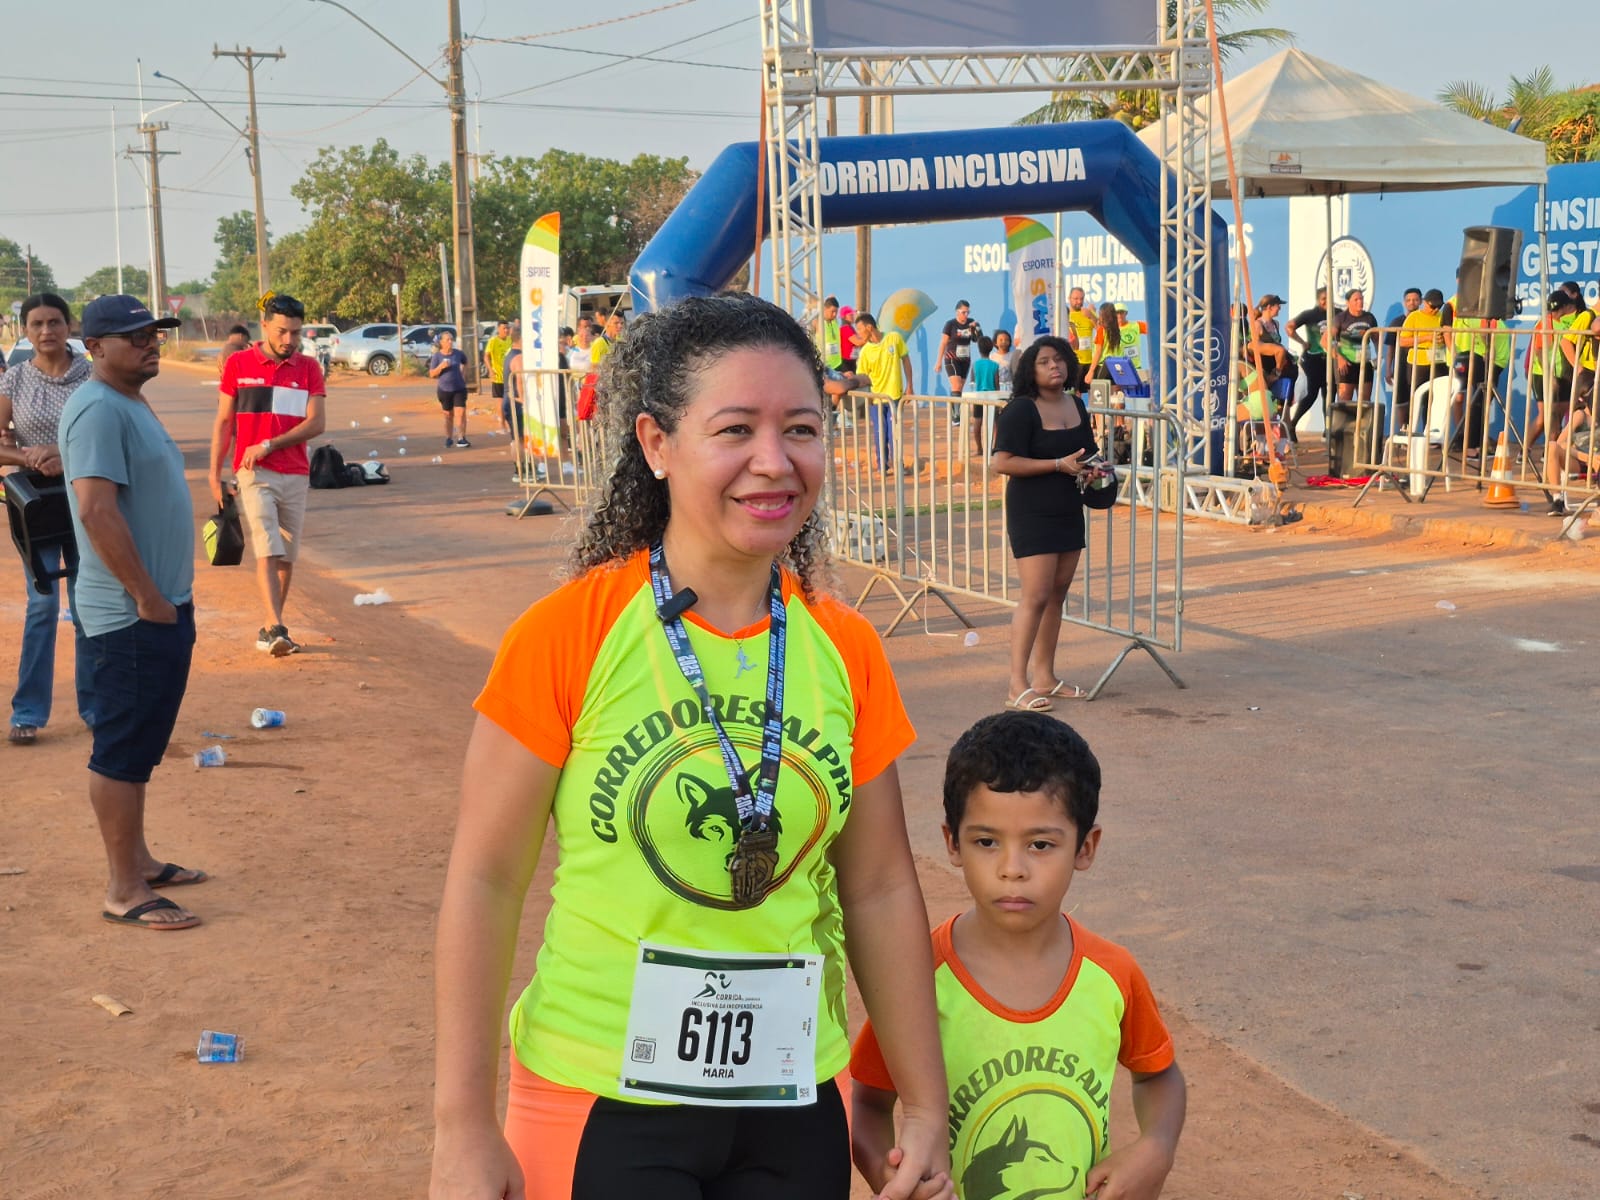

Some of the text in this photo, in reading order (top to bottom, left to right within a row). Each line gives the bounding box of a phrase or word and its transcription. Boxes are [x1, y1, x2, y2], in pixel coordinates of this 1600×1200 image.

[934, 148, 1086, 190] INCLUSIVA
[1534, 197, 1600, 233] ENSI
[965, 243, 1011, 272] ESCOL
[1078, 233, 1142, 266] MILITA
[677, 654, 701, 676] 2025
[589, 694, 851, 844] CORREDORES ALPHA
[735, 794, 754, 819] 2025
[755, 790, 774, 816] 2025
[716, 993, 742, 1001] CORRIDA
[677, 1007, 754, 1066] 6113
[702, 1067, 735, 1079] MARIA
